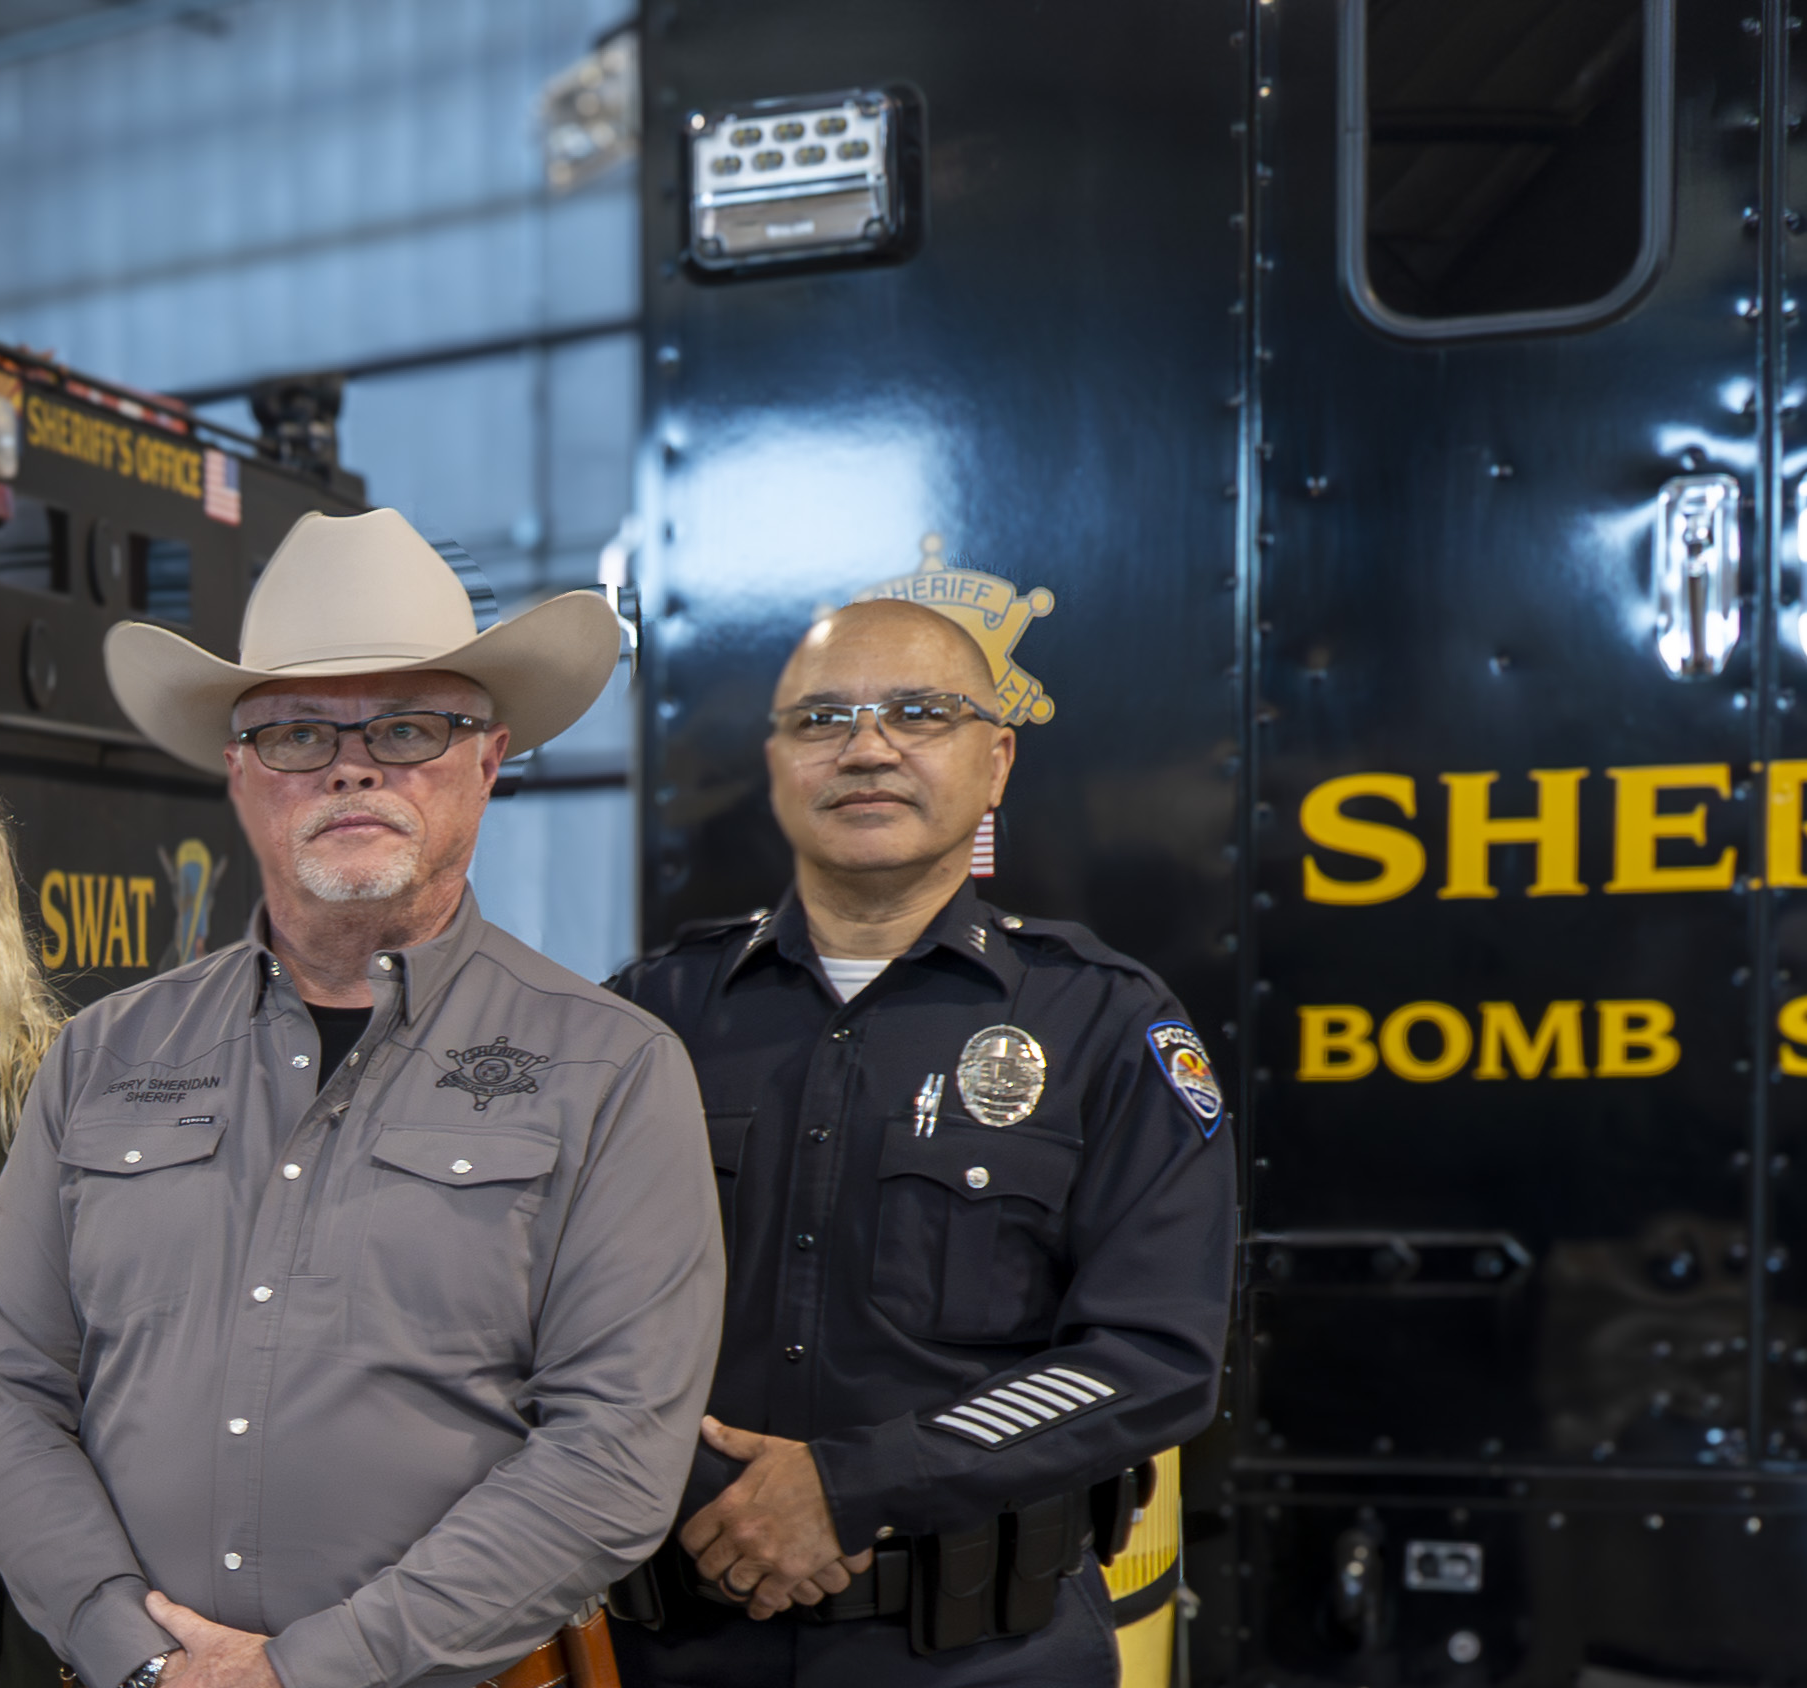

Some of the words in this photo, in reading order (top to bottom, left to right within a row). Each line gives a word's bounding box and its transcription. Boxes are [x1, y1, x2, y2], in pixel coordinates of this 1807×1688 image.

[26, 394, 134, 477] SHERIFF'S
[136, 433, 203, 499] OFFICE
[40, 869, 155, 970] SWAT
[1295, 999, 1682, 1082] BOMB
[125, 1091, 187, 1104] SHERIFF
[148, 1075, 221, 1091] SHERIDAN
